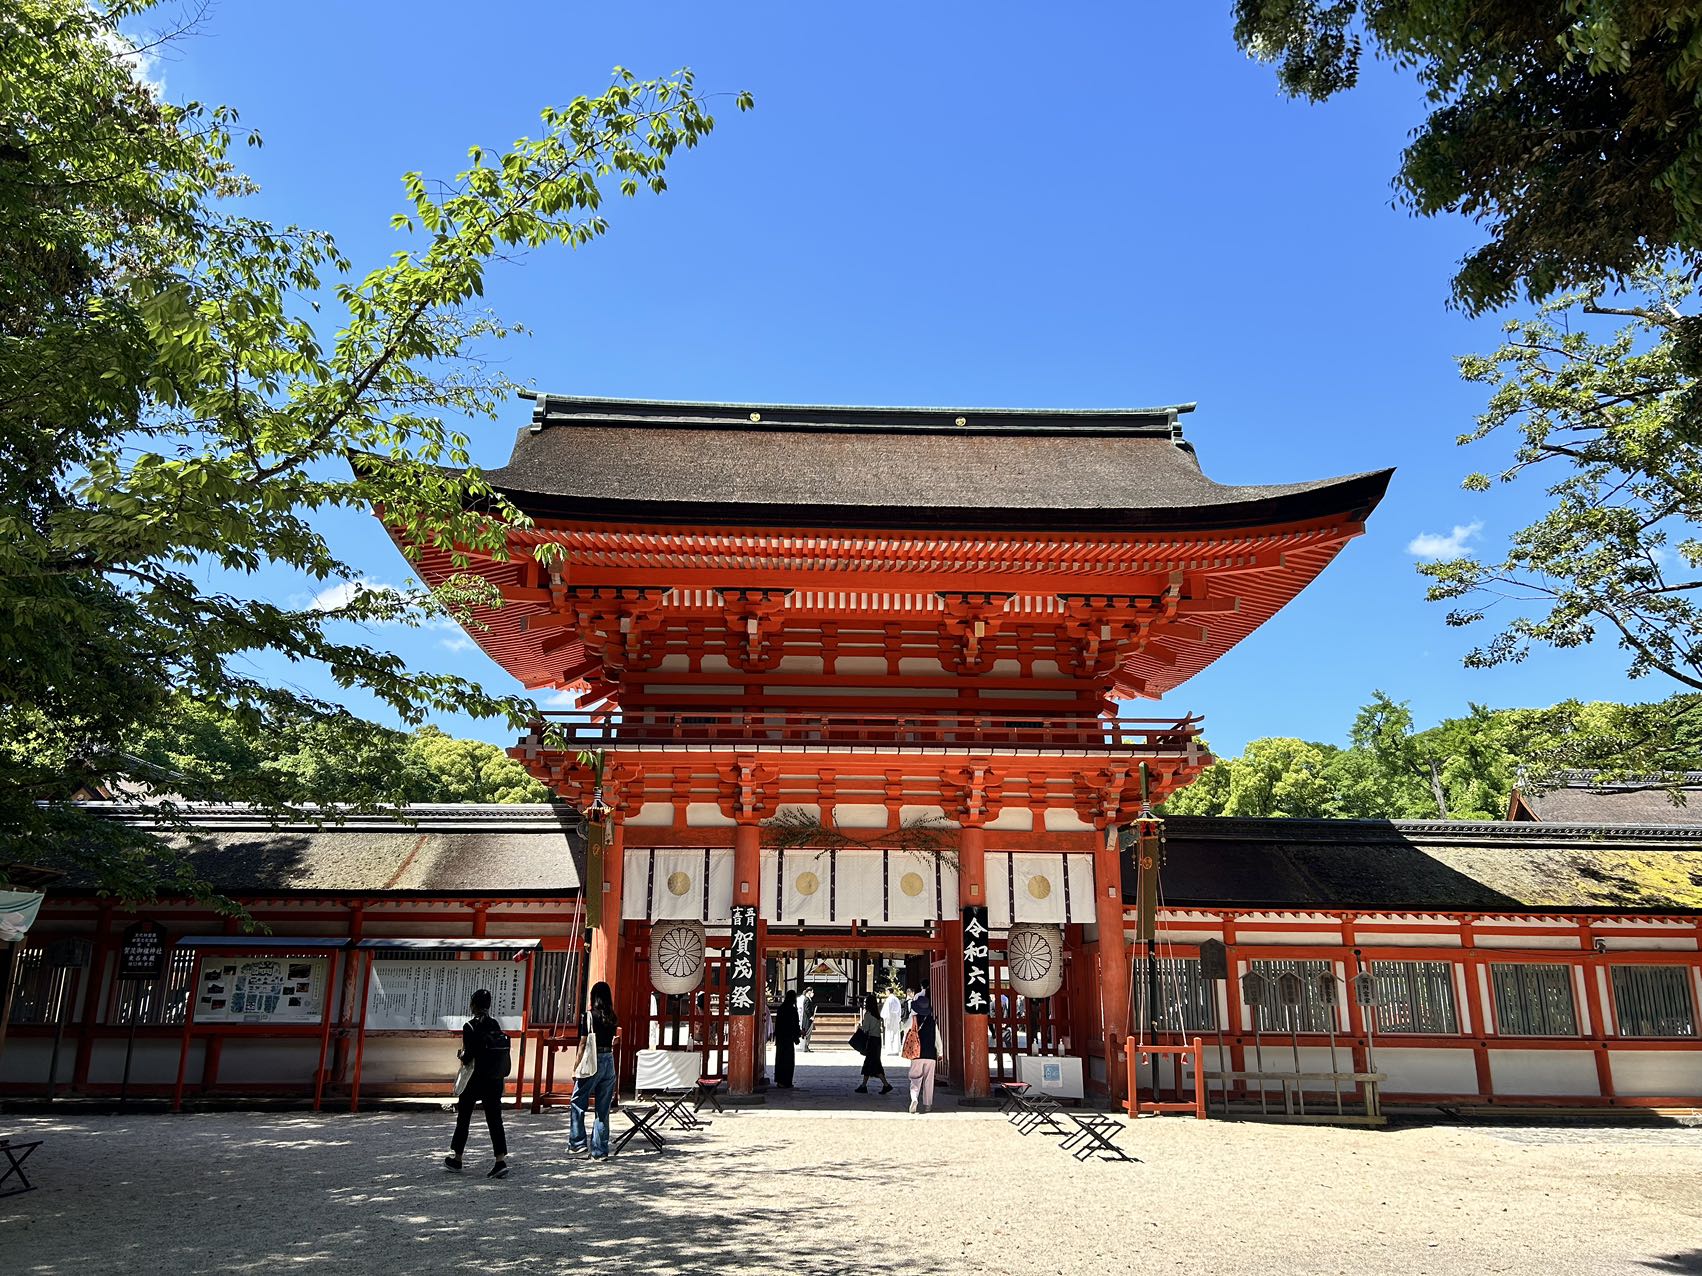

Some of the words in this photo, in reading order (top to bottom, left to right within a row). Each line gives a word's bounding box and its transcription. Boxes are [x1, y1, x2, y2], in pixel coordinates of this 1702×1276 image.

[745, 907, 756, 927] 五月
[730, 929, 754, 1008] 賀茂祭
[964, 917, 988, 1010] 令和六年
